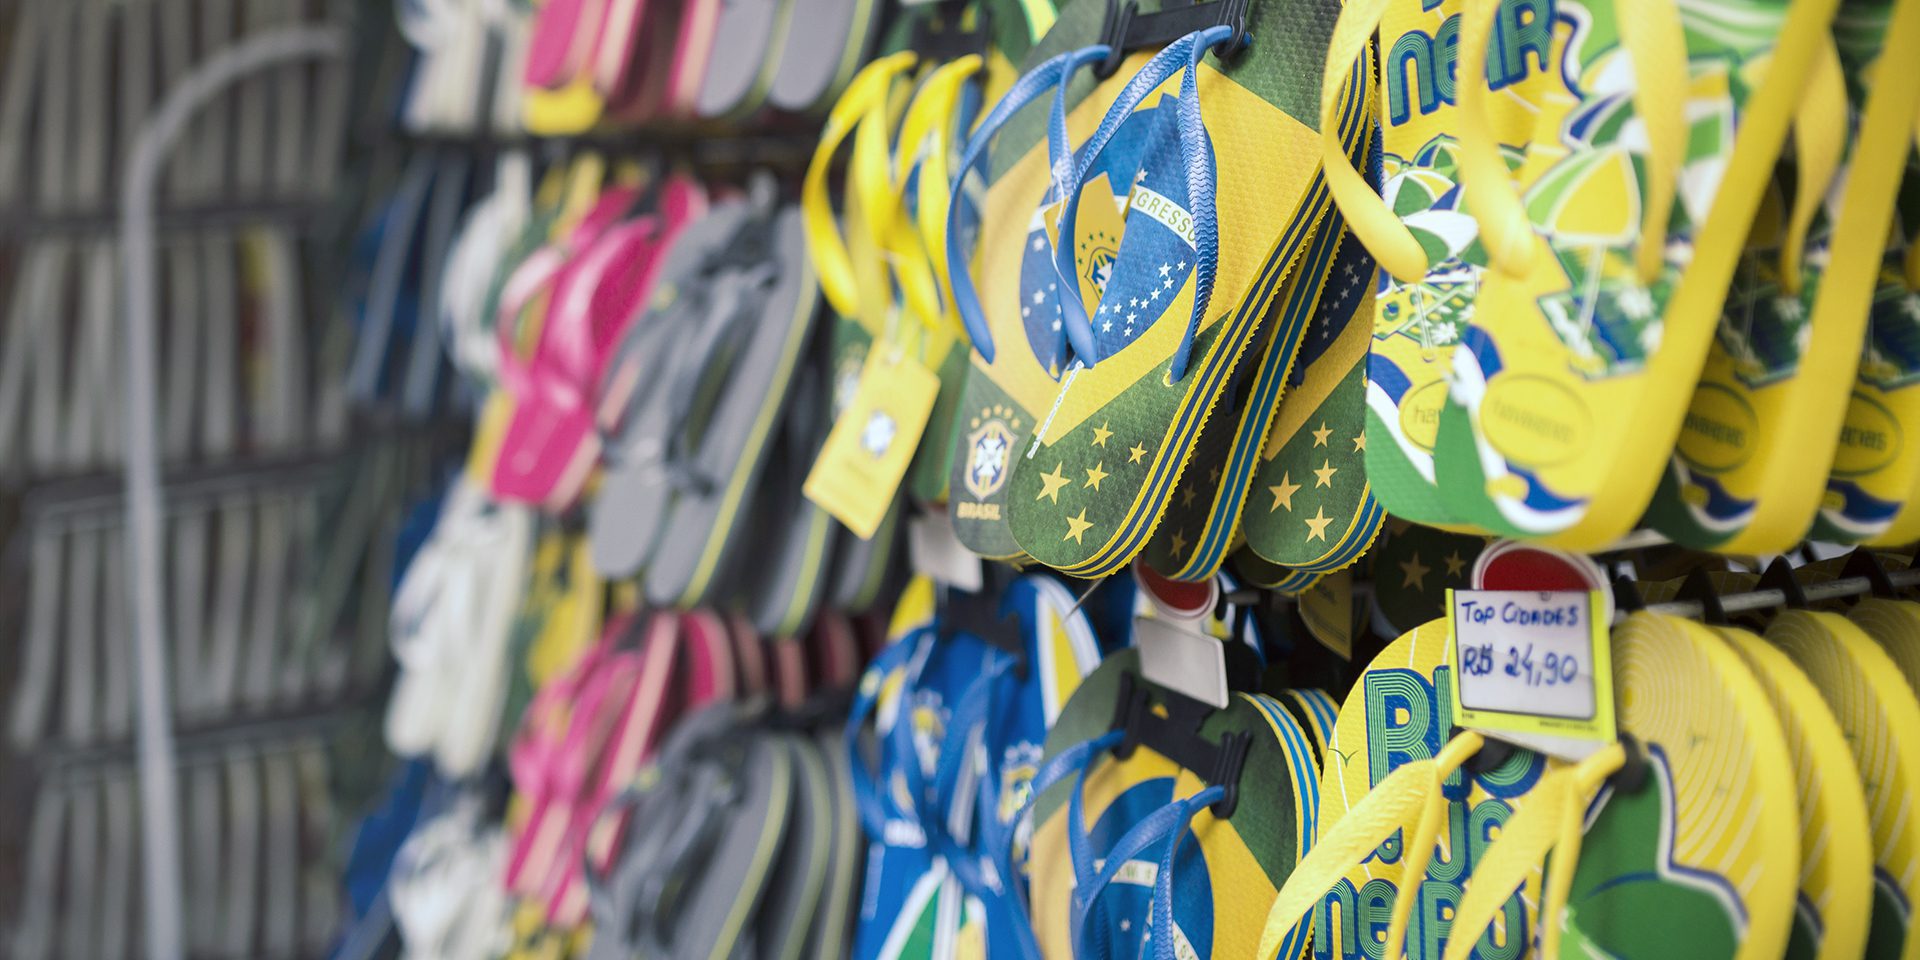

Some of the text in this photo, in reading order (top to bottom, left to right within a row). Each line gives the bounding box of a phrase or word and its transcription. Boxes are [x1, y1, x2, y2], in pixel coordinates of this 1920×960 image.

[957, 502, 1000, 520] BRASIL
[1462, 643, 1578, 687] R$ 24,90
